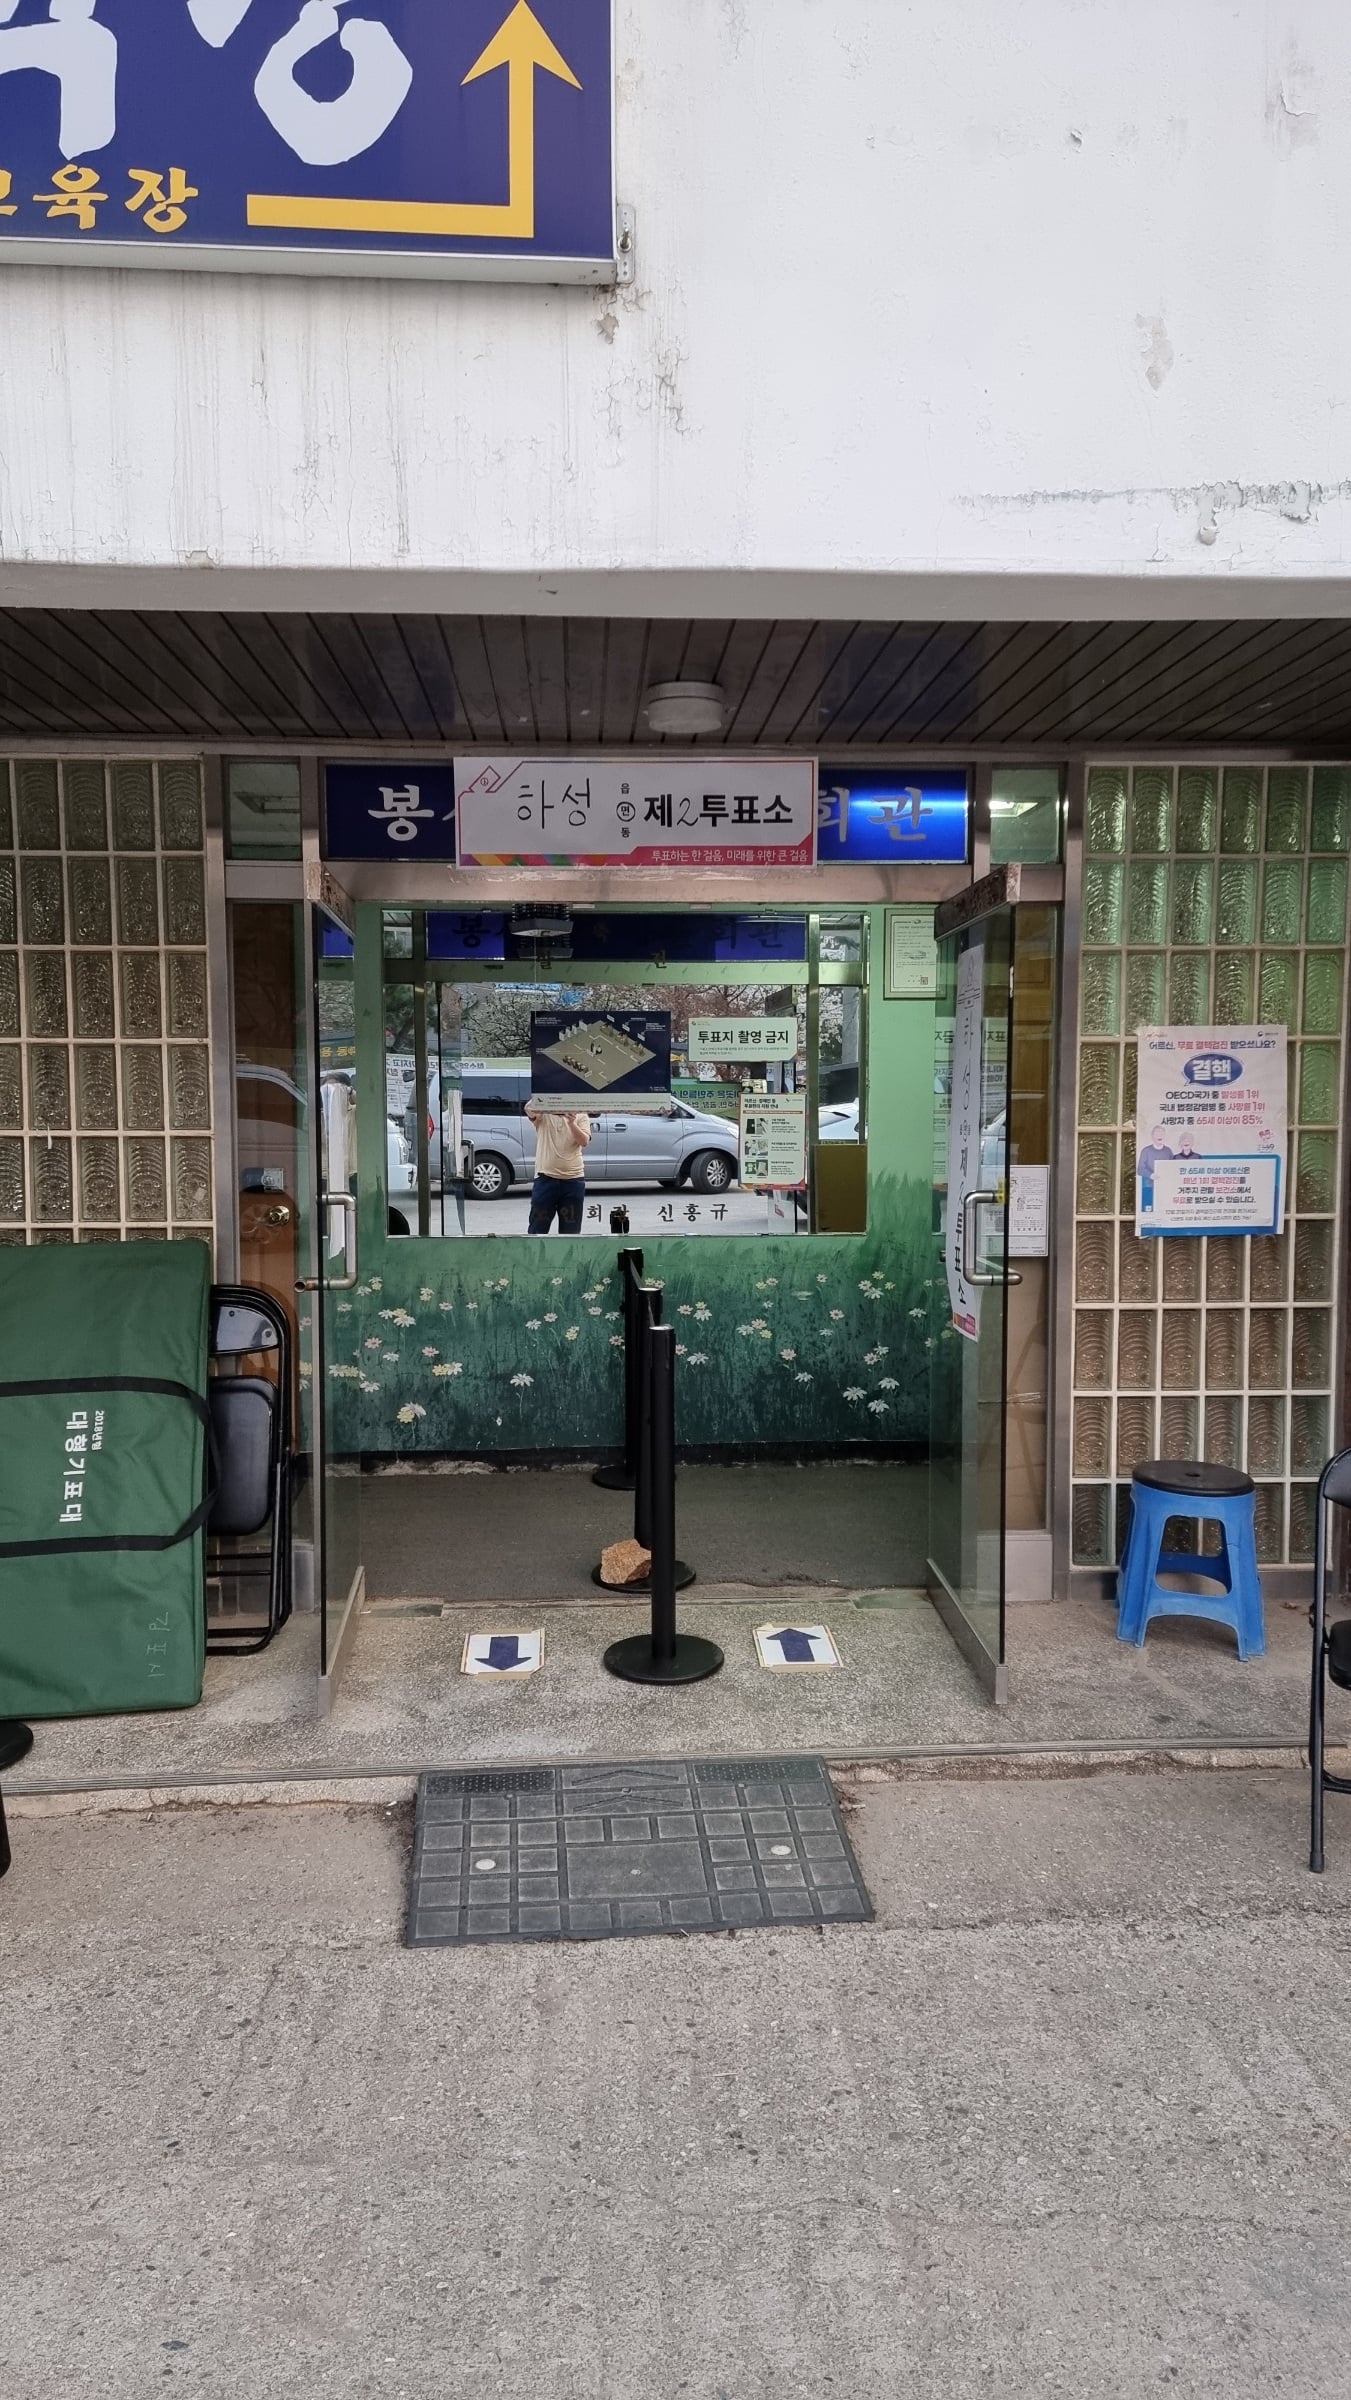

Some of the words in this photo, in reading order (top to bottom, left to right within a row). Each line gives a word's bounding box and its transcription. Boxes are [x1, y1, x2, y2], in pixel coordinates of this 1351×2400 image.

[517, 777, 590, 830] 하성
[643, 793, 794, 828] 제2투표소
[367, 784, 455, 842] 봉
[652, 849, 689, 862] 투표하는
[691, 849, 701, 862] 한
[703, 849, 724, 862] 걸음,
[726, 849, 755, 862] 미래를
[757, 849, 776, 862] 위한
[777, 850, 788, 862] 큰
[790, 849, 809, 862] 걸음
[697, 1030, 734, 1044] 투표지
[738, 1030, 762, 1044] 촬영
[765, 1030, 789, 1044] 금지
[1192, 1059, 1232, 1081] 결핵
[1165, 1091, 1210, 1100] OECD국가
[1246, 1089, 1259, 1099] 1위
[1160, 1103, 1175, 1112] 국내
[1253, 1101, 1265, 1111] 1위
[1160, 1117, 1185, 1125] 사망자
[1242, 1115, 1264, 1125] 85%
[657, 1203, 729, 1222] 신홍규
[59, 1410, 89, 1523] 대형기표대
